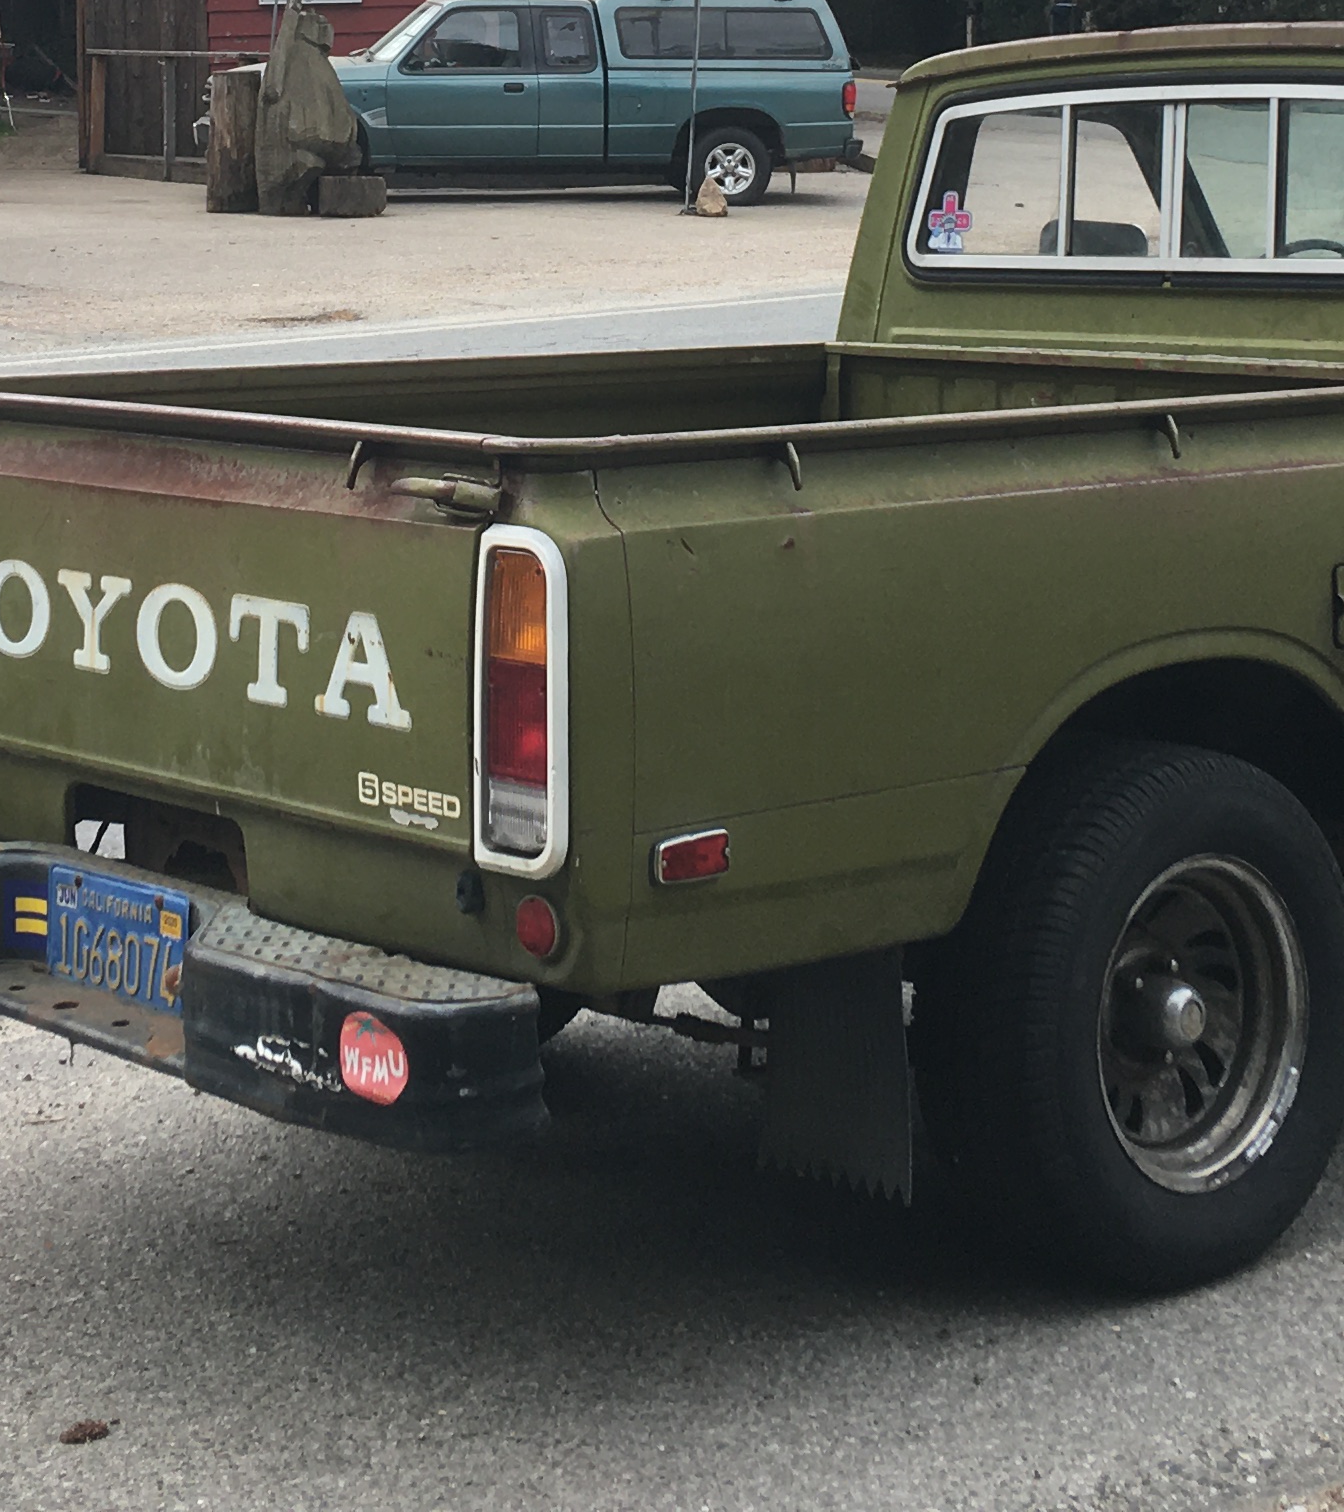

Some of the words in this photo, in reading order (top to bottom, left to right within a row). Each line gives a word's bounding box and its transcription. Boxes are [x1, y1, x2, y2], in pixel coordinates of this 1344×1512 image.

[359, 773, 378, 804] 5
[381, 781, 461, 819] SPEED
[59, 888, 76, 905] JUN
[82, 888, 153, 924] CALIFORNIA
[344, 1045, 405, 1086] WFMU
